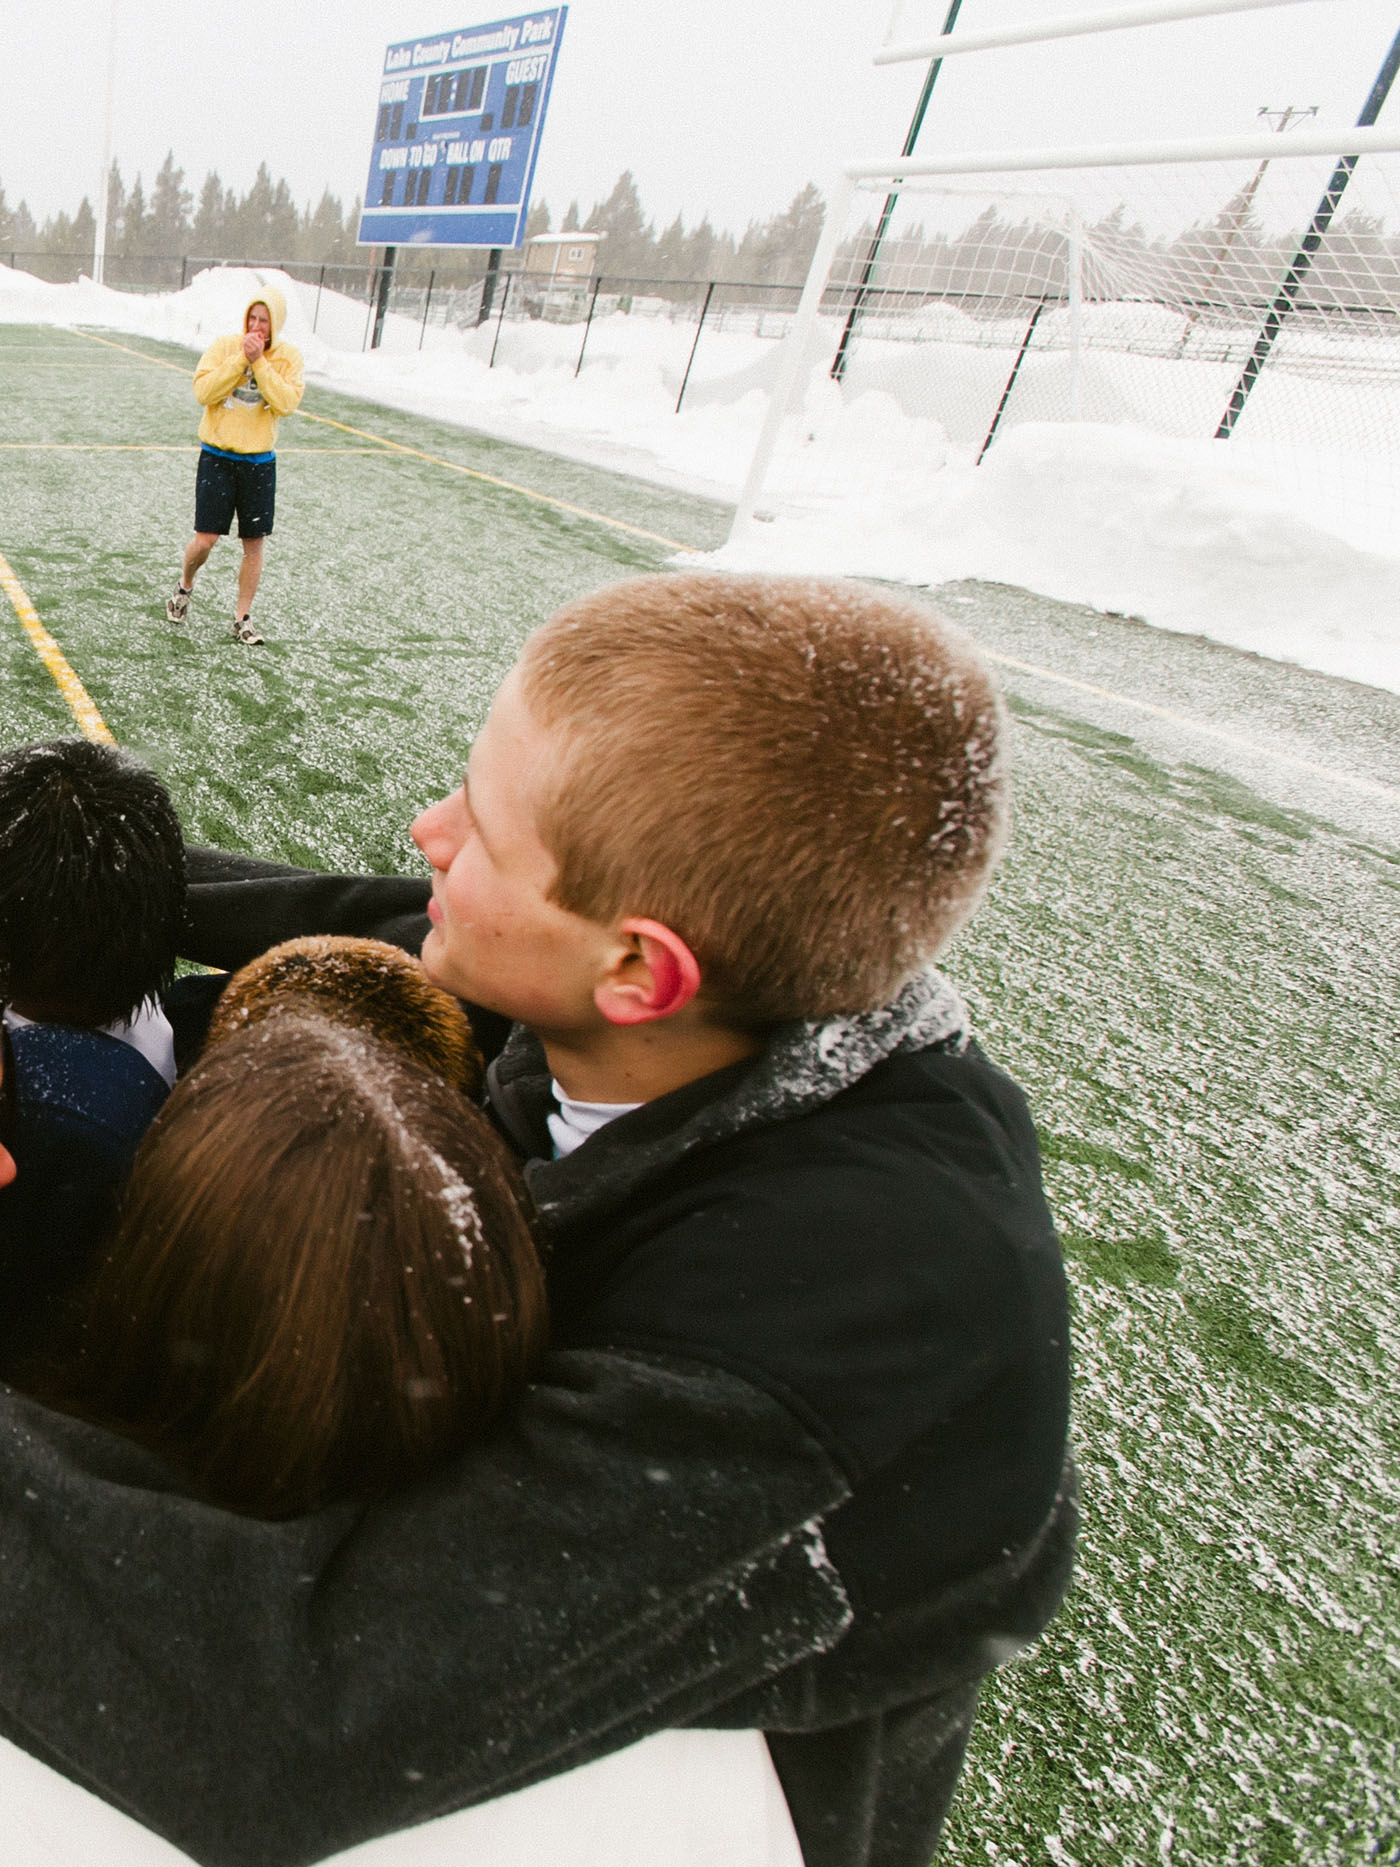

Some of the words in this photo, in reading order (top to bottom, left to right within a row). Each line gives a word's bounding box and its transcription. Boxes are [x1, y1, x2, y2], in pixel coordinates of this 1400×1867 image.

[413, 42, 451, 64] County
[452, 26, 520, 58] Community
[521, 17, 553, 44] Park
[506, 56, 547, 85] GUEST
[380, 80, 410, 104] HOME
[409, 146, 422, 168] TO
[447, 142, 469, 164] BALL
[470, 140, 485, 163] ON
[489, 137, 512, 162] QTR
